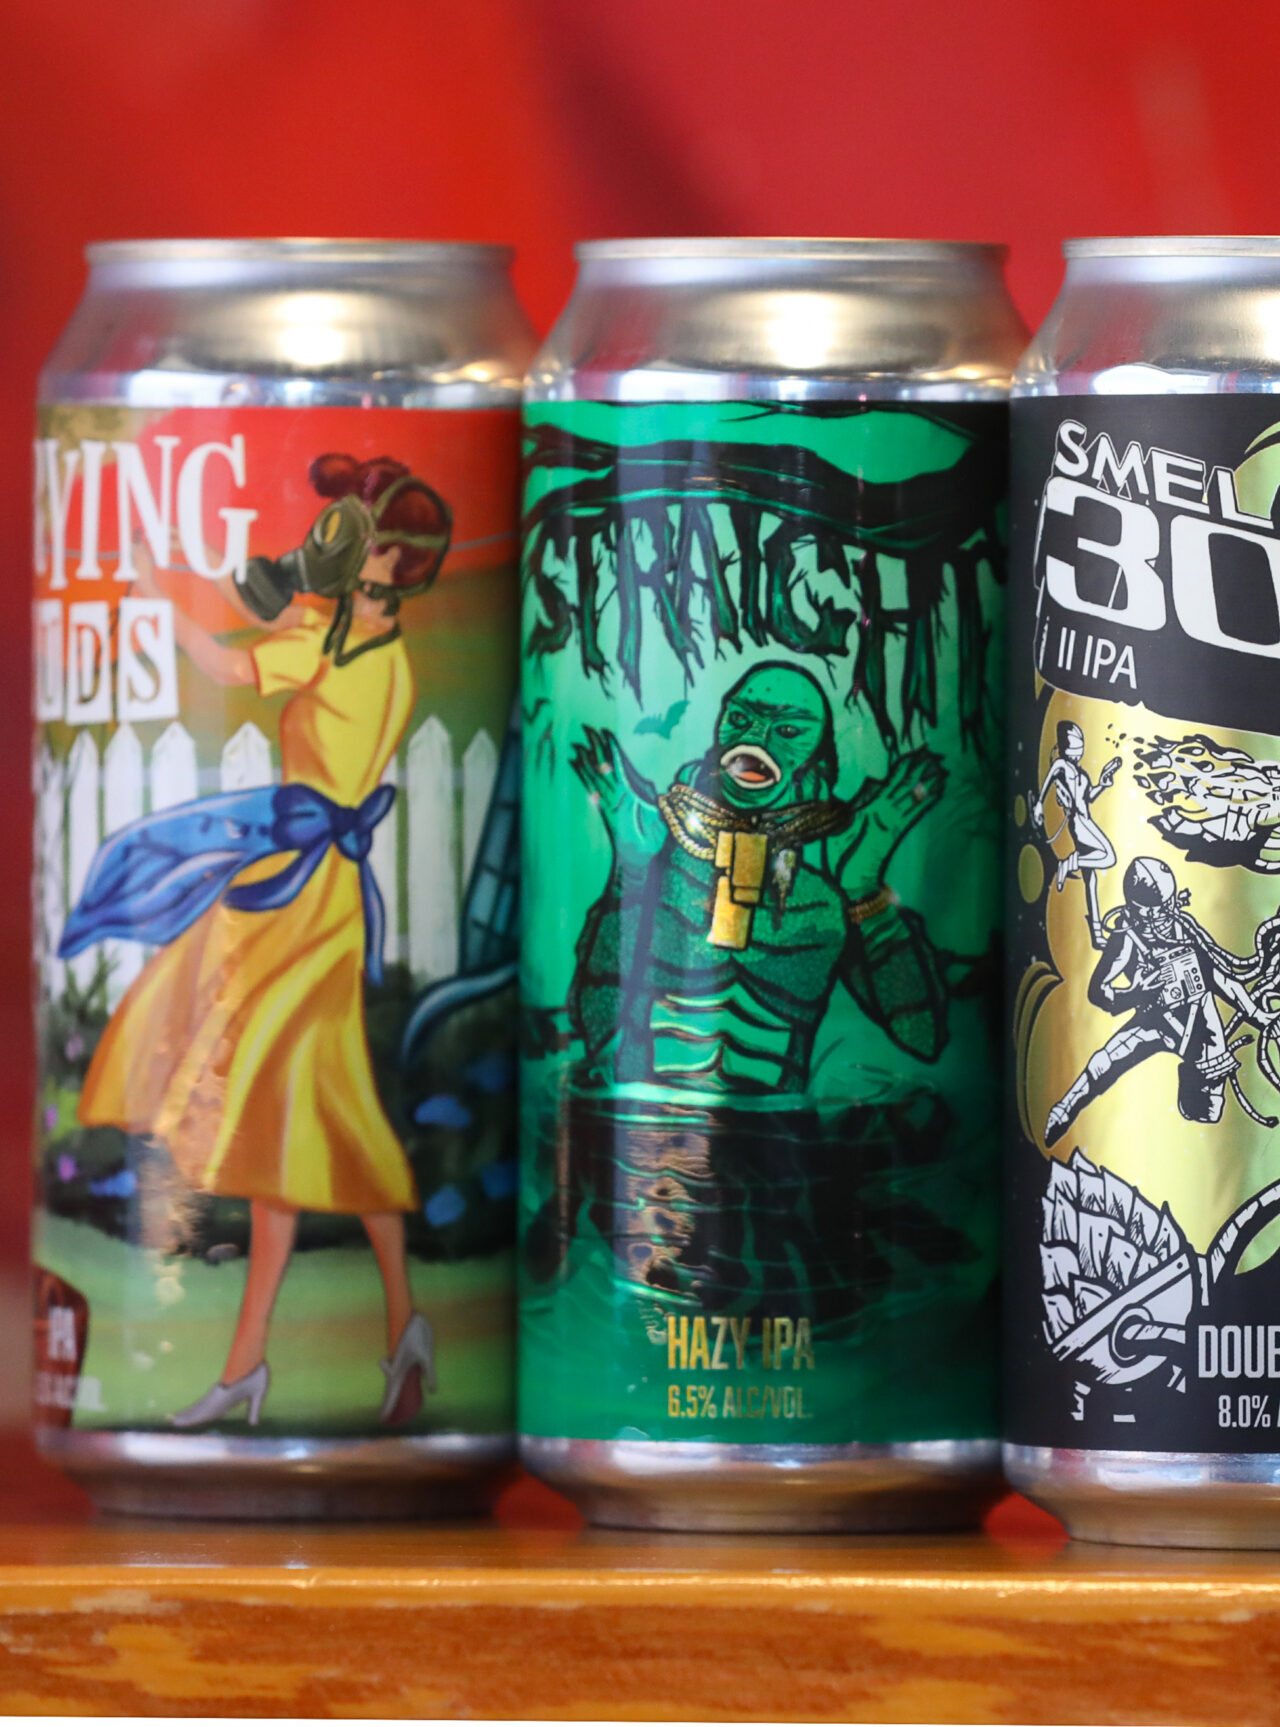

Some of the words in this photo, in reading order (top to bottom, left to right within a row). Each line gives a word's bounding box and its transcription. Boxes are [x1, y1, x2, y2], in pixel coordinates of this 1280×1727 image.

[1082, 634, 1137, 690] IPA
[667, 1316, 751, 1369] HAZY
[762, 1317, 815, 1370] IPA
[667, 1385, 718, 1418] 6.5%
[722, 1386, 814, 1418] ALC/VOL.
[1217, 1395, 1271, 1428] 8.0%
